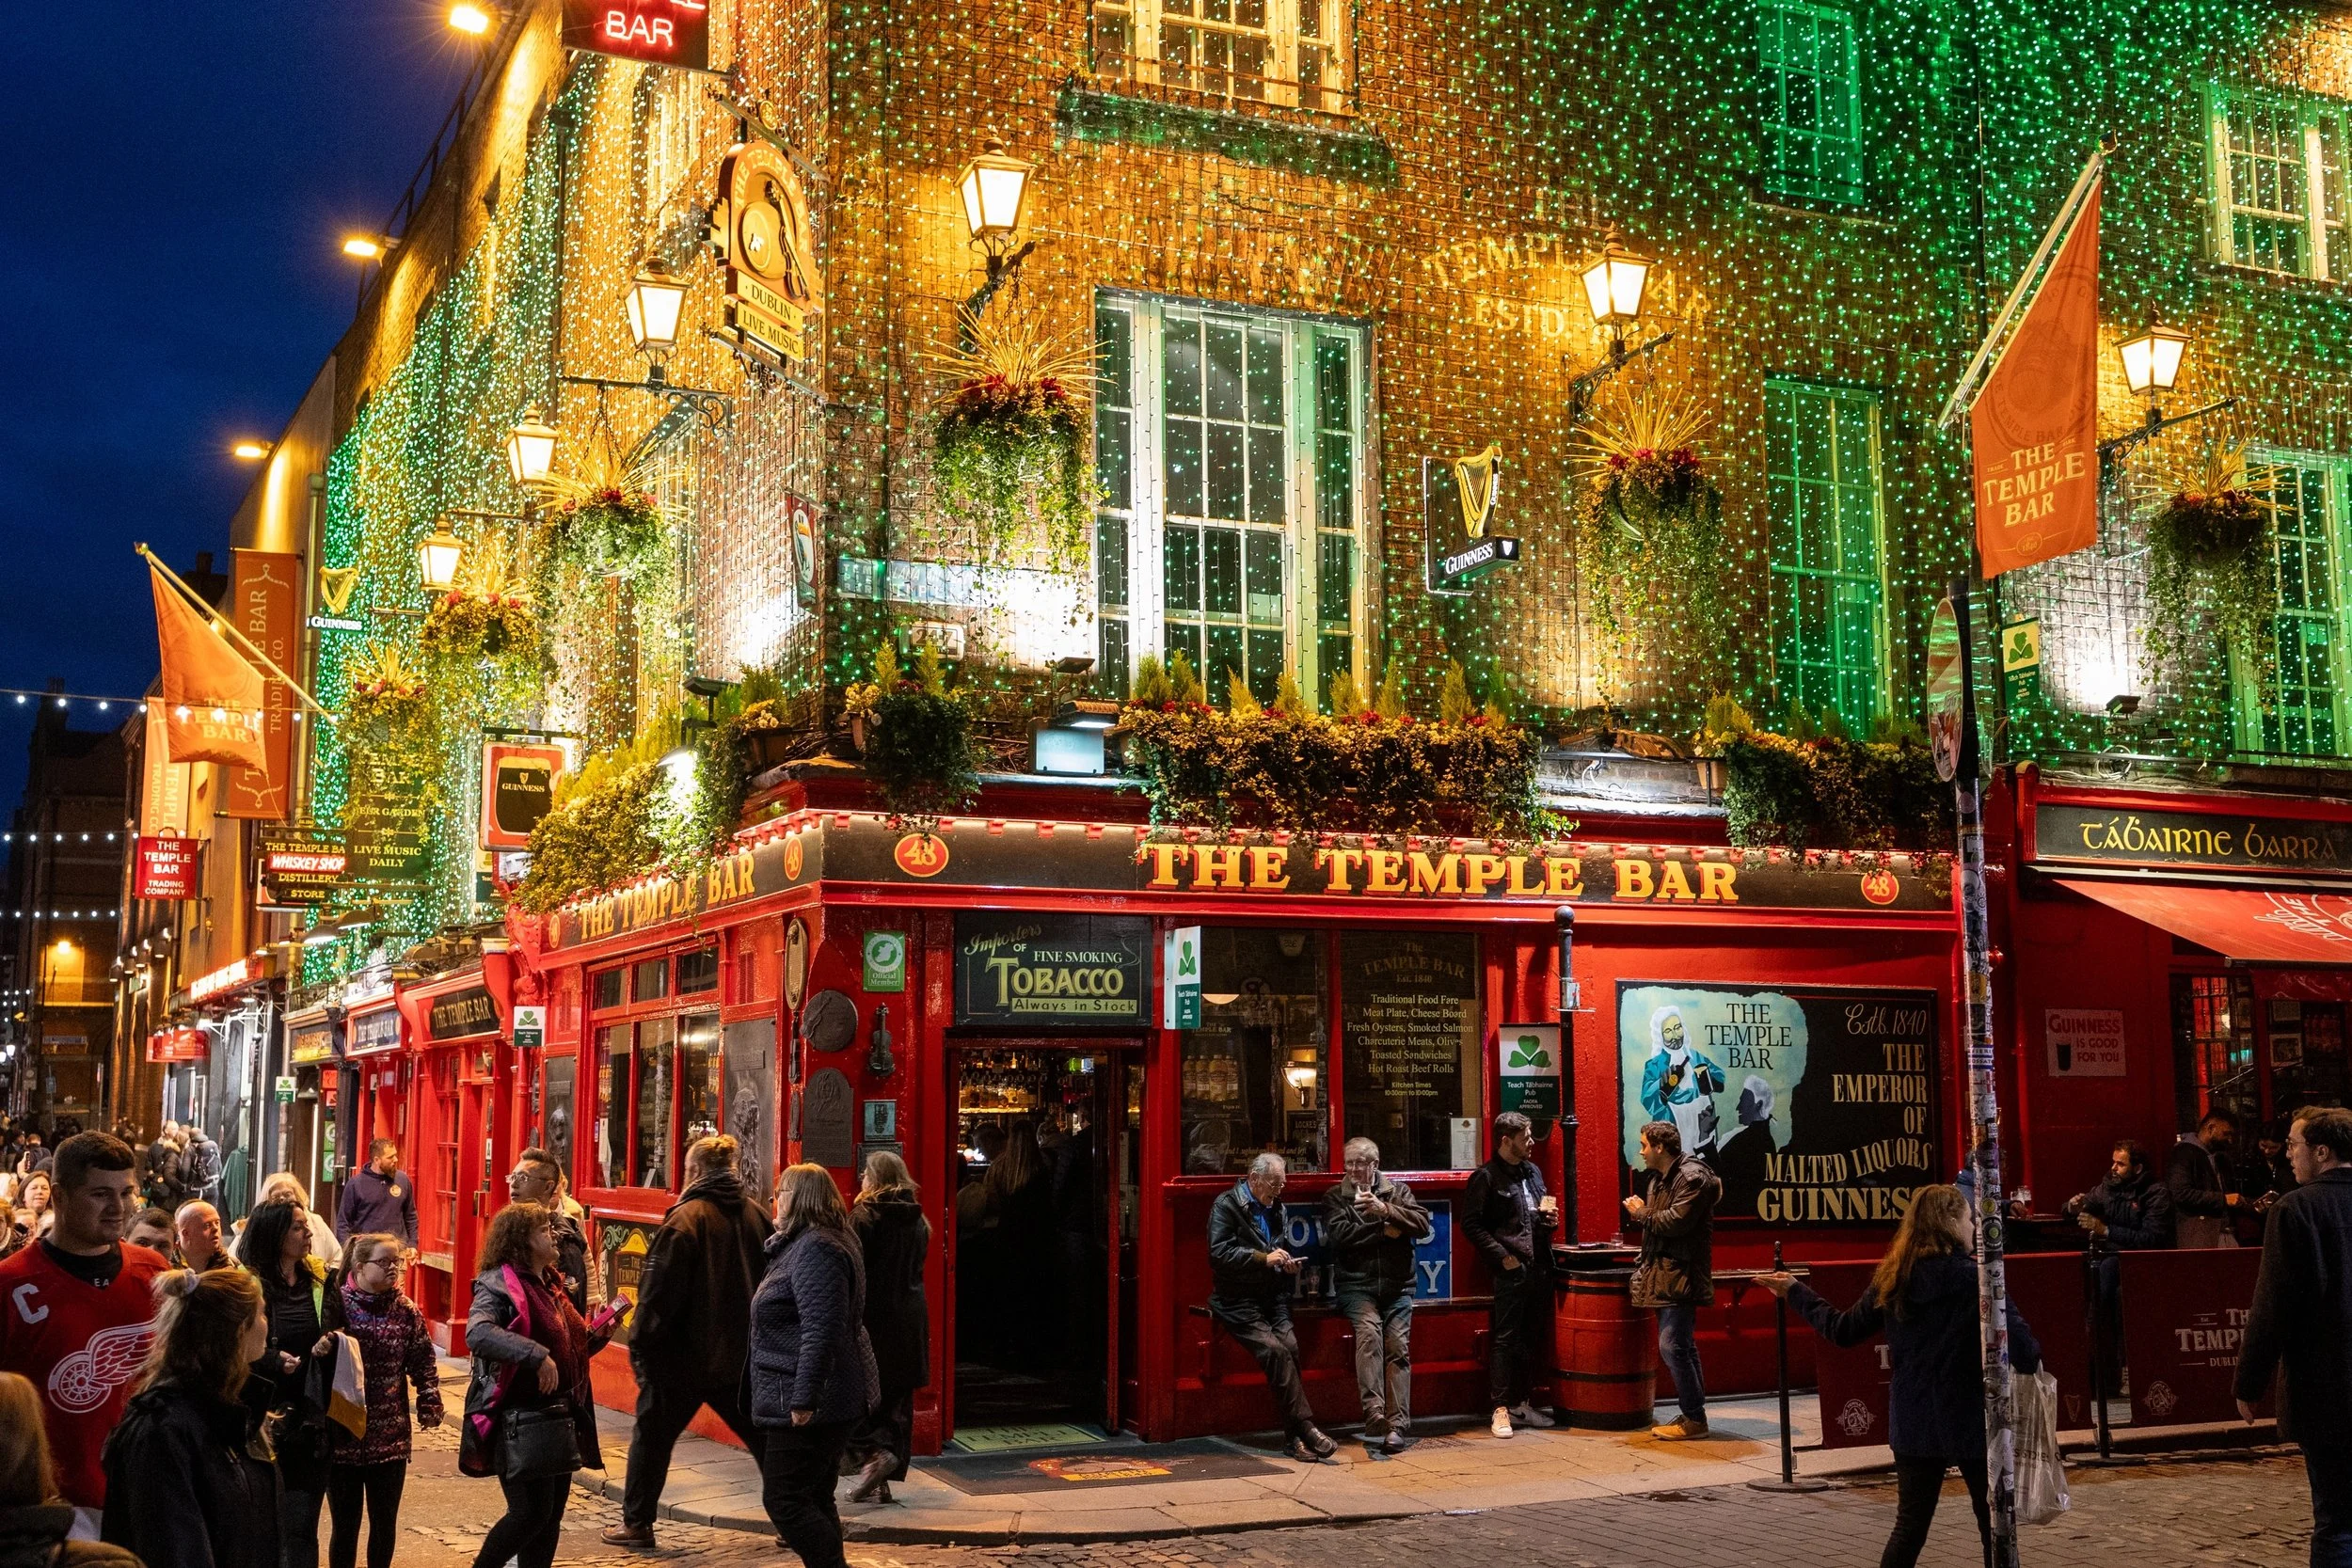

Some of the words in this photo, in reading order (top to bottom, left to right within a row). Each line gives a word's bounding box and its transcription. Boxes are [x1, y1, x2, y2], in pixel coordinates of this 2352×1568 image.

[606, 10, 674, 47] BAR
[735, 161, 750, 210] THE
[747, 149, 796, 197] TEMPLE
[792, 199, 809, 254] BAR
[751, 284, 792, 322] DUBLIN
[742, 310, 765, 335] LIVE
[768, 329, 799, 356] MUSIC
[2011, 442, 2056, 470] THE
[1983, 451, 2086, 508] TEMPLE
[2005, 491, 2056, 528] BAR
[1445, 542, 1494, 575] GUINNESS
[248, 590, 267, 633] BAR
[310, 616, 363, 631] GUINNESS
[202, 724, 249, 744] BAR
[501, 782, 546, 793] GUINNESS
[157, 840, 181, 851] THE
[265, 842, 286, 852] THE
[288, 843, 330, 854] TEMPLE
[331, 844, 346, 854] BA
[353, 845, 382, 855] LIVE
[383, 846, 422, 857] MUSIC
[904, 839, 938, 866] 48
[144, 851, 191, 863] TEMPLE
[270, 855, 317, 872] WHISKEY
[317, 856, 346, 871] SHOP
[369, 858, 405, 867] DAILY
[787, 846, 801, 875] 48
[153, 863, 180, 875] BAR
[278, 873, 340, 883] DISTILLERY
[1136, 842, 1293, 893] THE
[1313, 847, 1585, 900] TEMPLE
[1611, 858, 1740, 905] BAR
[144, 887, 185, 896] COMPANY
[147, 879, 184, 889] TRADING
[290, 889, 326, 899] STORE
[1866, 877, 1890, 898] 48
[579, 898, 615, 940] THE
[619, 870, 698, 930] TEMPLE
[707, 852, 755, 906] BAR
[963, 924, 1042, 958] Importers
[1012, 942, 1027, 953] OF
[1034, 951, 1063, 963] FINE
[1065, 951, 1123, 964] SMOKING
[1360, 956, 1428, 978] TEMPLE
[1434, 958, 1467, 979] BAR
[985, 956, 1125, 1007] TOBACCO
[1413, 974, 1433, 984] 1840
[1013, 999, 1066, 1013] Always
[1074, 1000, 1088, 1011] in
[1092, 999, 1136, 1012] Stock
[1371, 994, 1416, 1005] Traditional
[1418, 994, 1439, 1005] Food
[1440, 995, 1459, 1005] Fare
[432, 1006, 447, 1030] THE
[447, 1001, 474, 1025] TEMPLE
[473, 995, 492, 1022] BAR
[1362, 1008, 1385, 1019] Meat
[1386, 1007, 1409, 1020] Plate,
[1411, 1007, 1441, 1019] Cheese
[1441, 1008, 1468, 1019] Board
[1725, 1003, 1772, 1025] THE
[1892, 1007, 1927, 1037] 1840
[1346, 1022, 1371, 1033] Fresh
[1372, 1022, 1406, 1035] Oysters,
[1407, 1022, 1441, 1033] Smoked
[1442, 1022, 1474, 1033] Salmon
[2048, 1013, 2121, 1035] GUINNESS
[1358, 1036, 1406, 1047] Charcuterie
[1407, 1036, 1436, 1048] Meats,
[1437, 1037, 1464, 1047] Olives
[1704, 1024, 1793, 1048] TEMPLE
[2075, 1037, 2086, 1049] IS
[2088, 1037, 2119, 1050] GOOD
[1370, 1049, 1403, 1060] Toasted
[1403, 1049, 1452, 1060] Sandwiches
[1727, 1047, 1774, 1071] BAR
[1882, 1043, 1926, 1072] THE
[2076, 1052, 2098, 1063] FOR
[2099, 1052, 2121, 1064] YOU
[1368, 1064, 1384, 1074] Hot
[1386, 1064, 1409, 1074] Roast
[1411, 1064, 1432, 1074] Beef
[1432, 1064, 1454, 1074] Rolls
[1832, 1074, 1929, 1104] EMPEROR
[1902, 1105, 1928, 1134] OF
[1764, 1152, 1849, 1185] MALTED
[1850, 1137, 1933, 1179] LIQUORS
[11, 1283, 50, 1324] C
[2225, 1308, 2251, 1326] TH
[2174, 1328, 2245, 1353] TEMP
